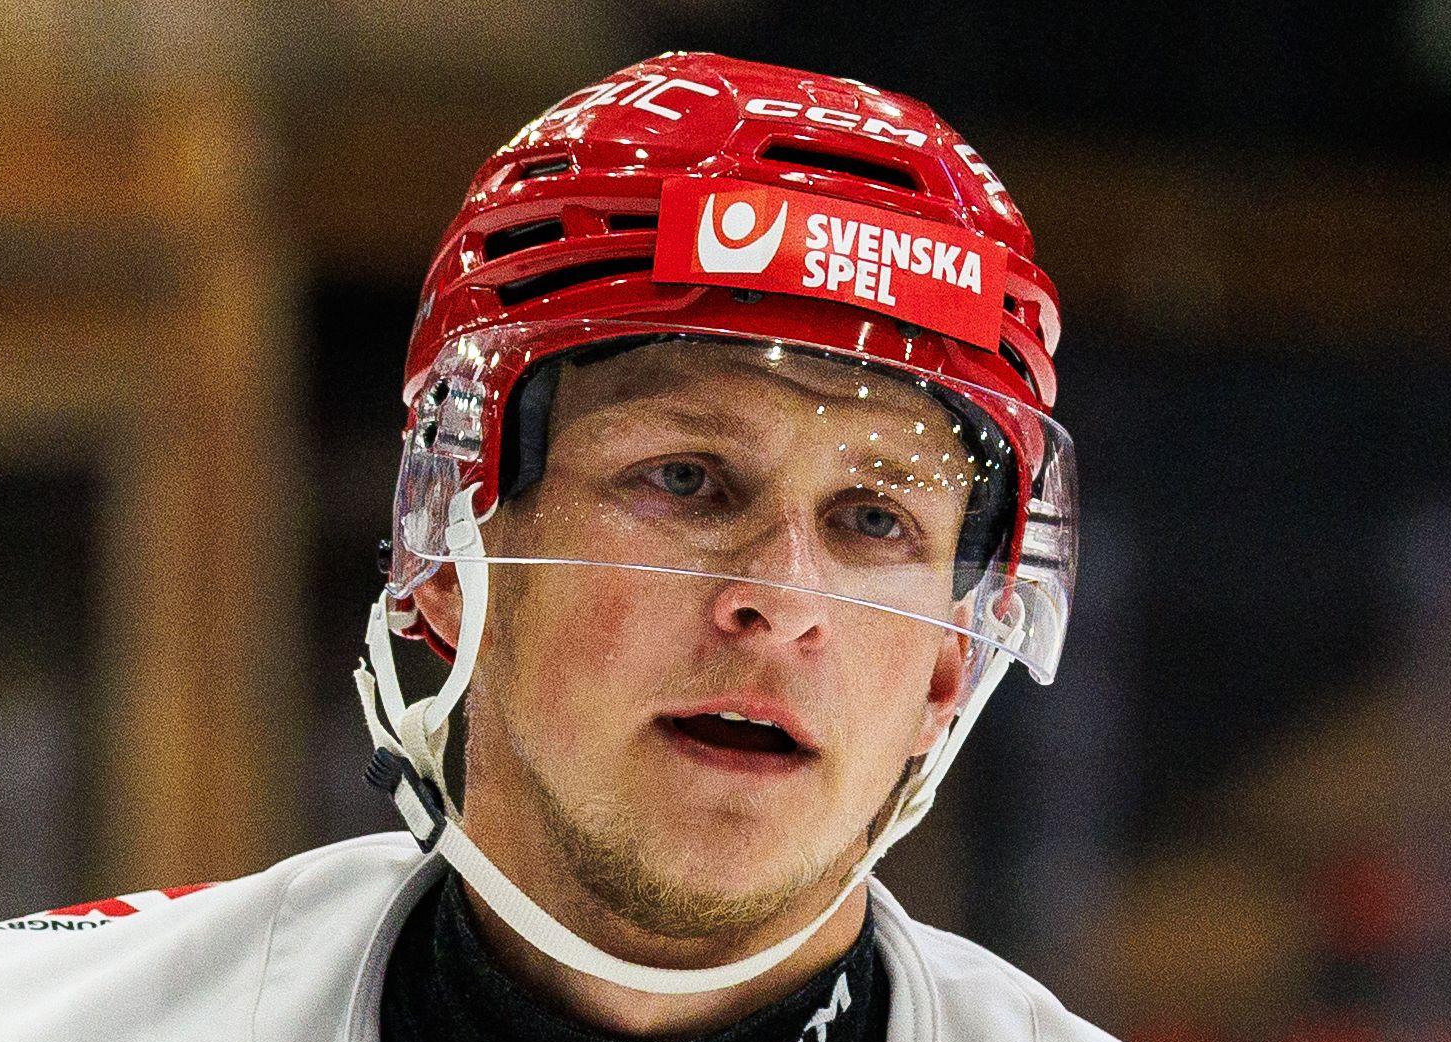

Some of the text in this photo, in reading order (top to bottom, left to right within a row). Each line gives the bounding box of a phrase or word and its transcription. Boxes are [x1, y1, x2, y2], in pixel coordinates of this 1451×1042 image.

[744, 98, 928, 147] CCM
[802, 250, 896, 307] SPEL
[805, 213, 982, 295] SVENSKA
